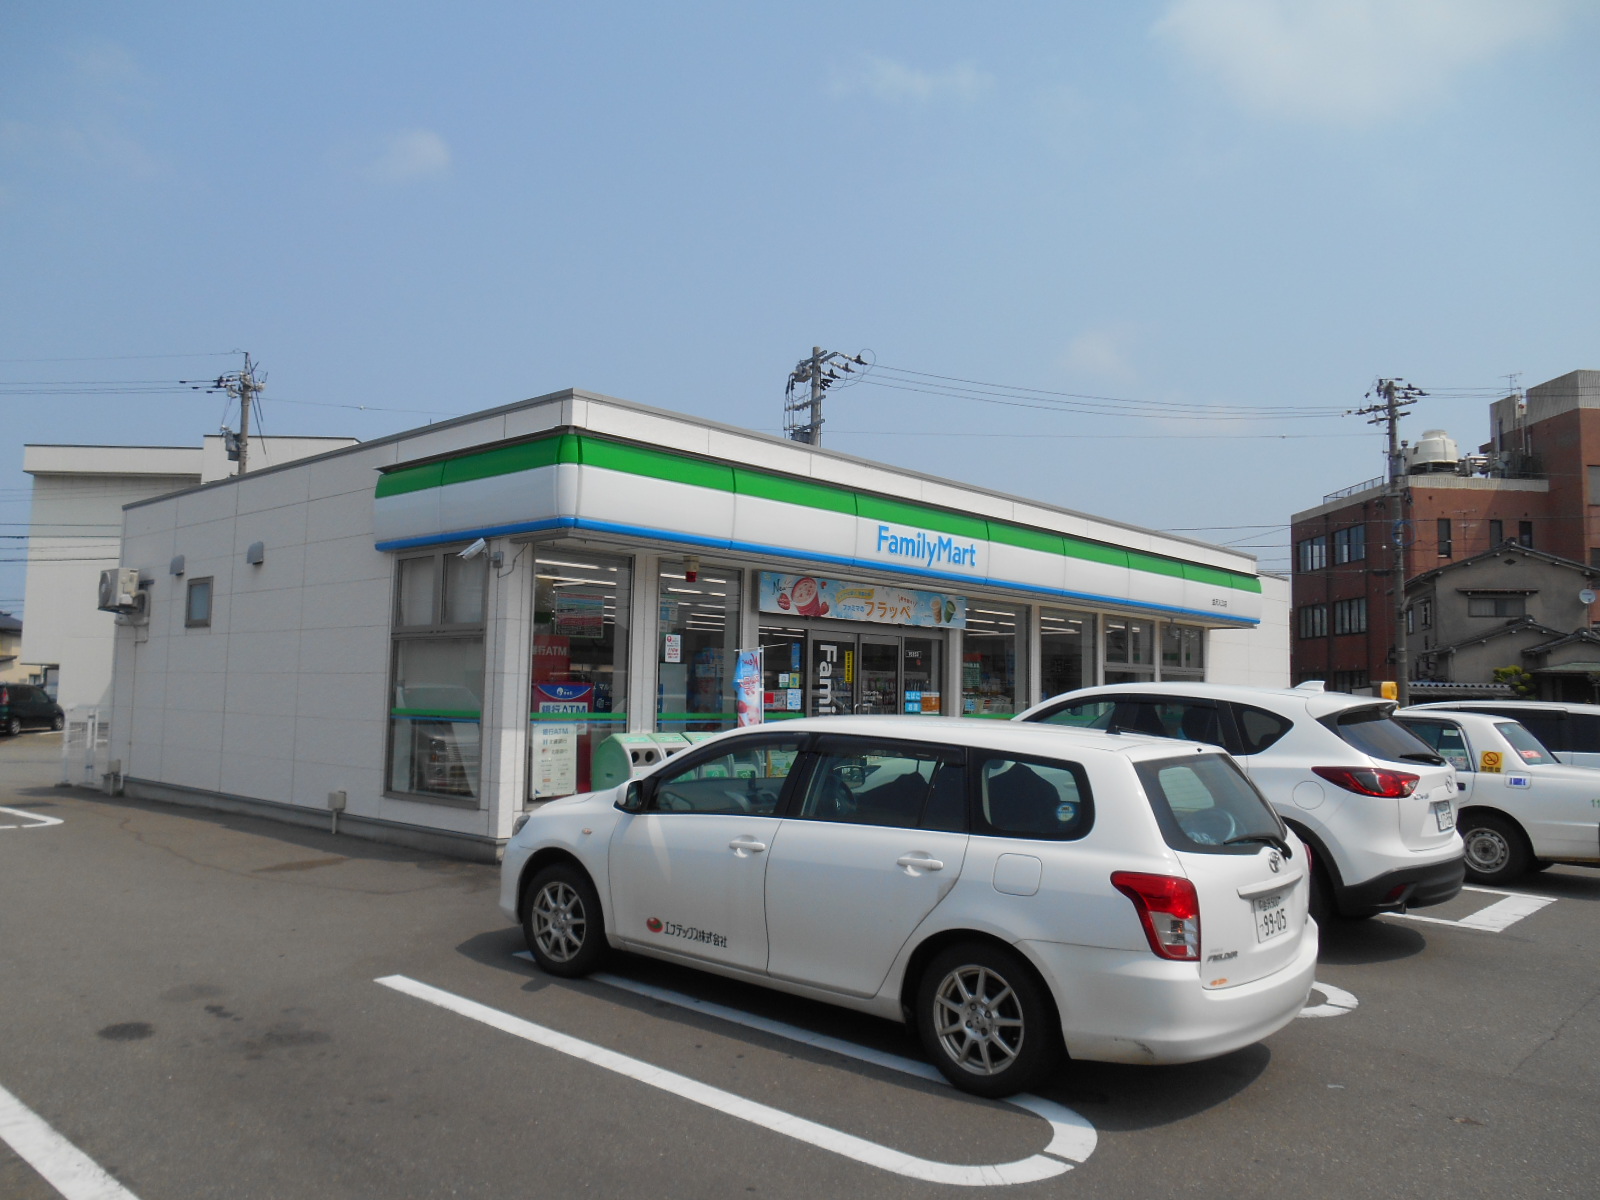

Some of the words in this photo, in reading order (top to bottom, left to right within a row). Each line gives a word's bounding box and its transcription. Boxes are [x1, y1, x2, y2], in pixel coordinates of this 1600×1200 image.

[877, 524, 977, 567] FamilyMart
[865, 601, 912, 620] フラッペ
[1264, 908, 1287, 936] 99-05
